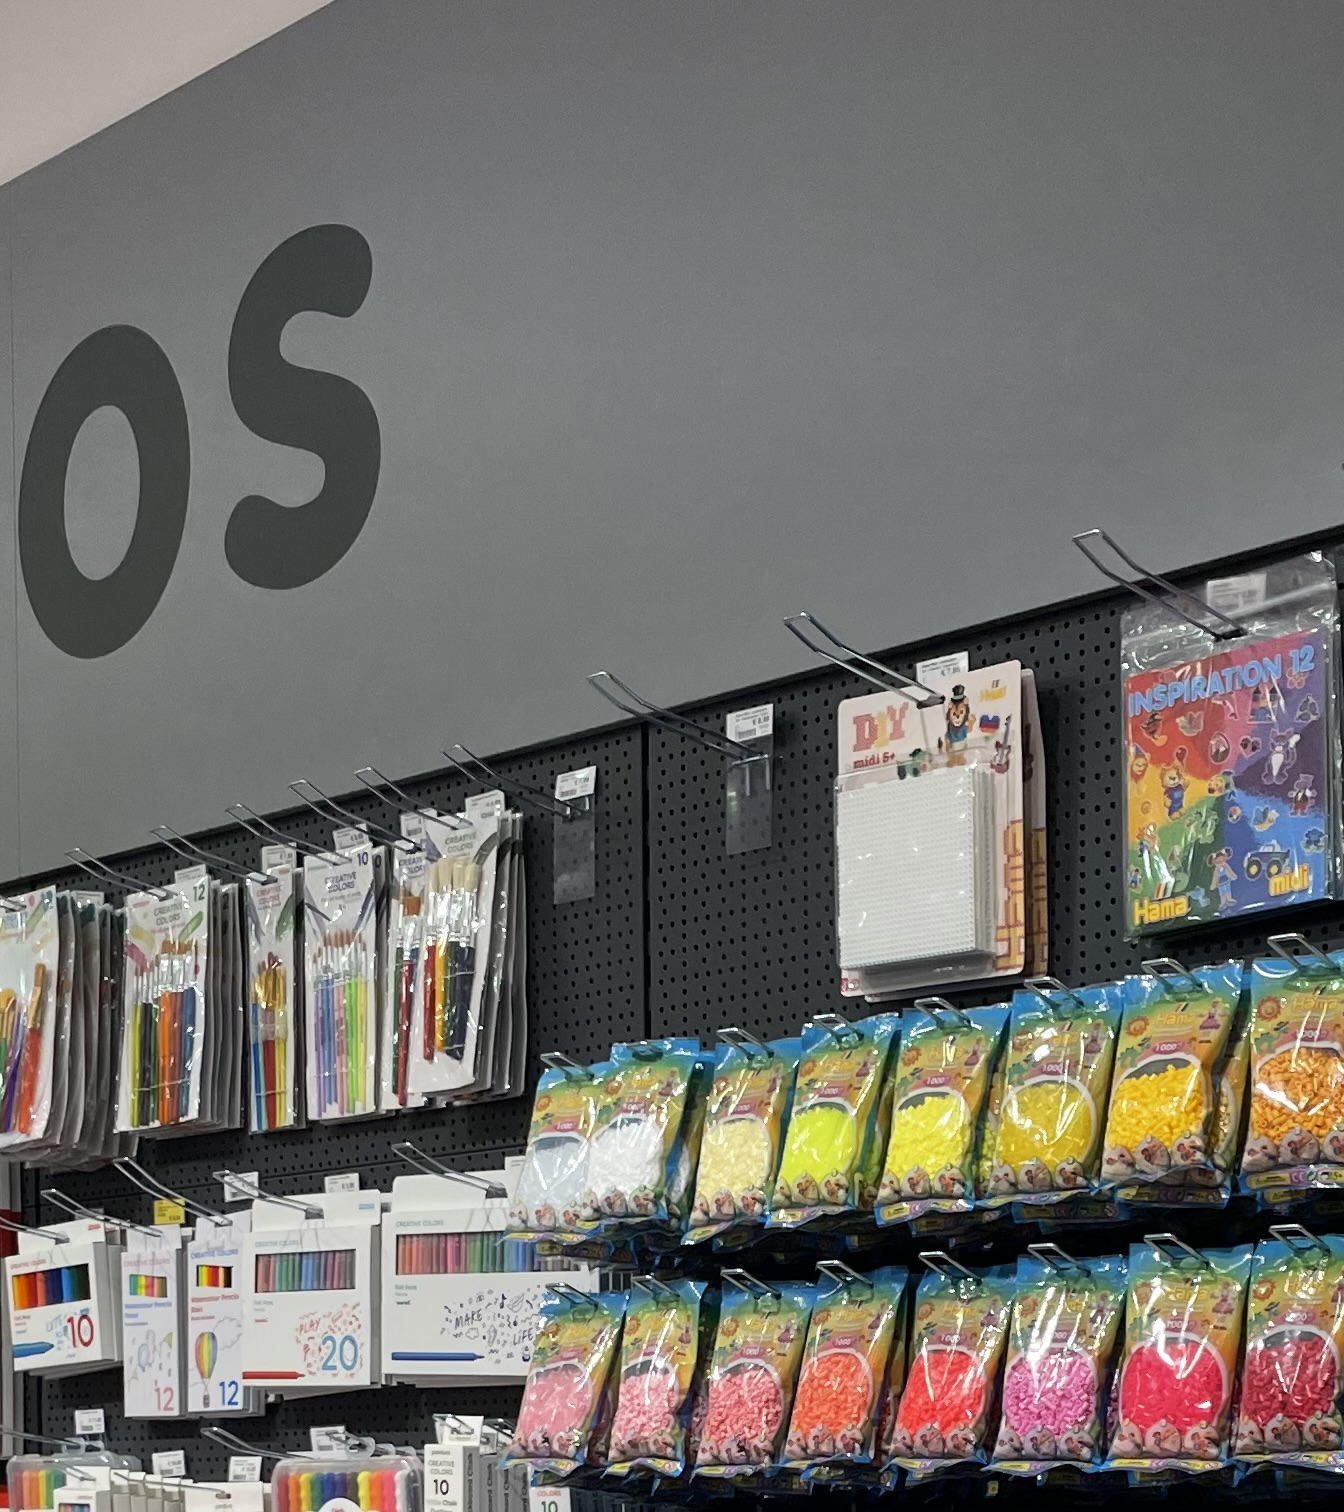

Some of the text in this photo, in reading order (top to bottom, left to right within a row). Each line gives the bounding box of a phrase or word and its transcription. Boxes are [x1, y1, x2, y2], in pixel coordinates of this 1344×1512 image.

[1128, 645, 1314, 717] INSPIRATION 12
[853, 702, 909, 752] DIY
[853, 752, 896, 769] midi 5+
[357, 852, 368, 866] 10
[192, 885, 205, 901] 12
[1269, 871, 1309, 896] midi
[1133, 895, 1188, 926] Hama
[68, 1314, 94, 1348] 10
[455, 1309, 483, 1328] MAKE
[321, 1334, 358, 1371] 20
[155, 1387, 174, 1412] 12
[219, 1381, 239, 1406] 12
[433, 1479, 449, 1496] 10
